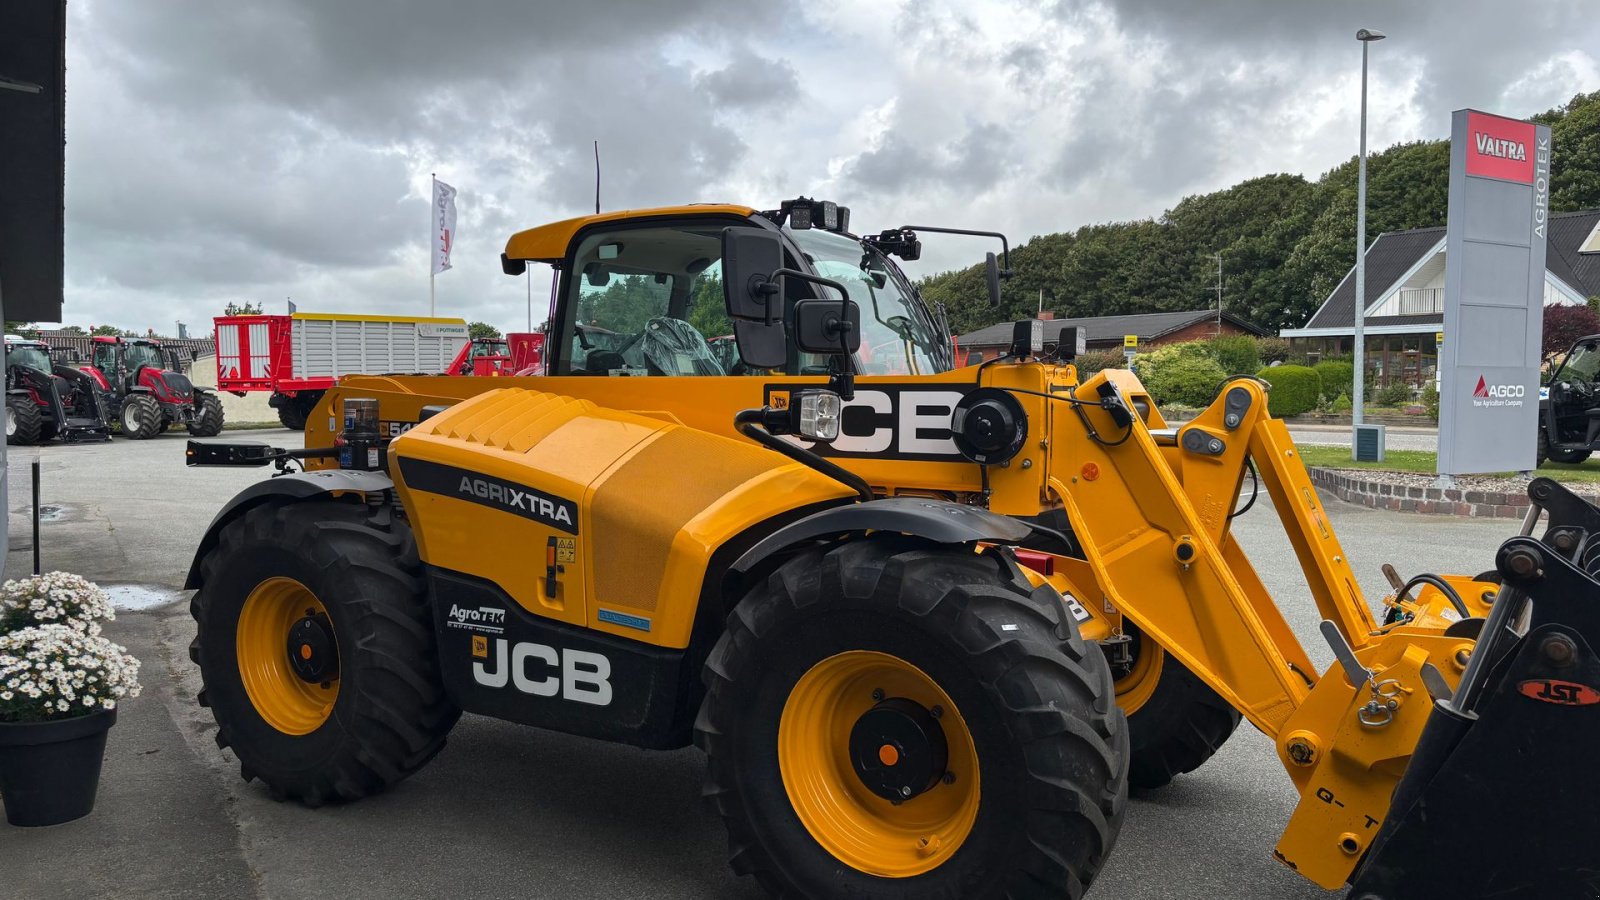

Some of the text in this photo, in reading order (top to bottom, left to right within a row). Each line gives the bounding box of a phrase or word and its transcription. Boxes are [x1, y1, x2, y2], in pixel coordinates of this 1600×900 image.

[1474, 131, 1526, 162] VALTRA
[1534, 137, 1548, 239] AGROTEK
[1489, 385, 1525, 398] AGCO
[458, 476, 572, 526] AGRIXTRA
[449, 604, 506, 624] AgroTEK
[472, 638, 614, 706] JCB
[1537, 682, 1583, 703] JST
